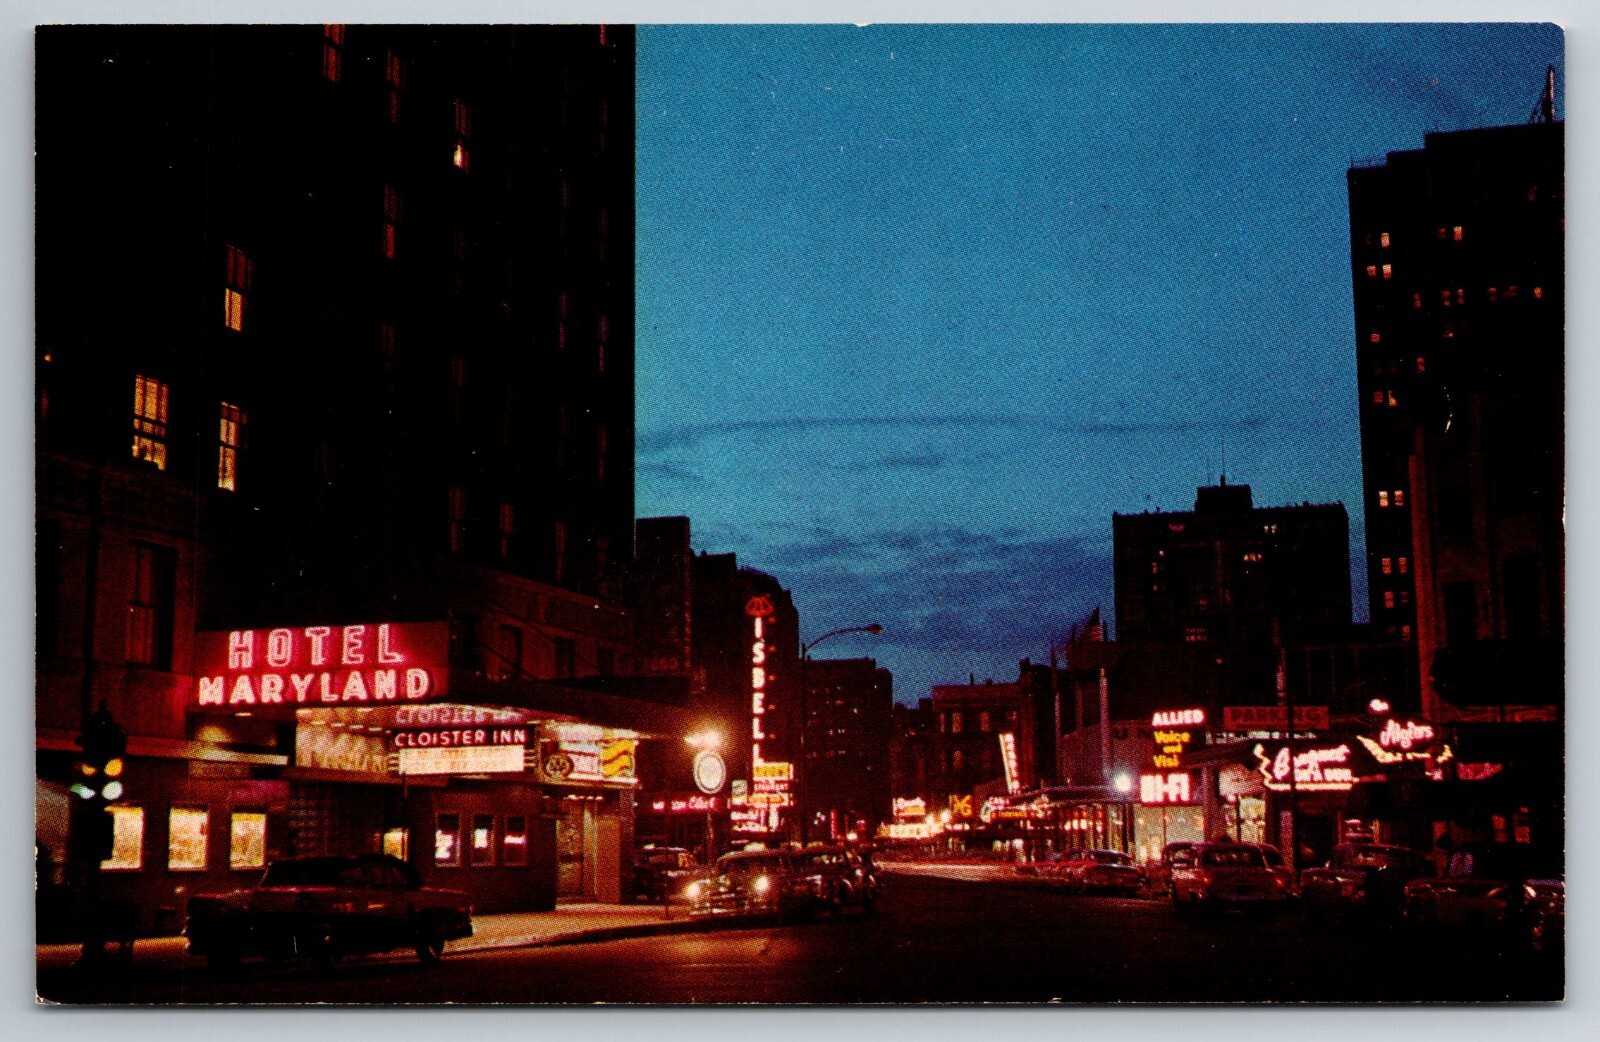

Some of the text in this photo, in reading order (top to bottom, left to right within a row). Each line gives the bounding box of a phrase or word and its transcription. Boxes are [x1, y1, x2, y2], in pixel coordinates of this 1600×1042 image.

[228, 623, 405, 669] HOTEL
[198, 668, 430, 705] MARYLAND
[1152, 709, 1205, 727] ALLIED
[1229, 707, 1322, 723] PARKNG
[394, 729, 526, 747] CLOISTER INN
[1153, 730, 1191, 744] Voice
[1139, 772, 1191, 803] HI-FI
